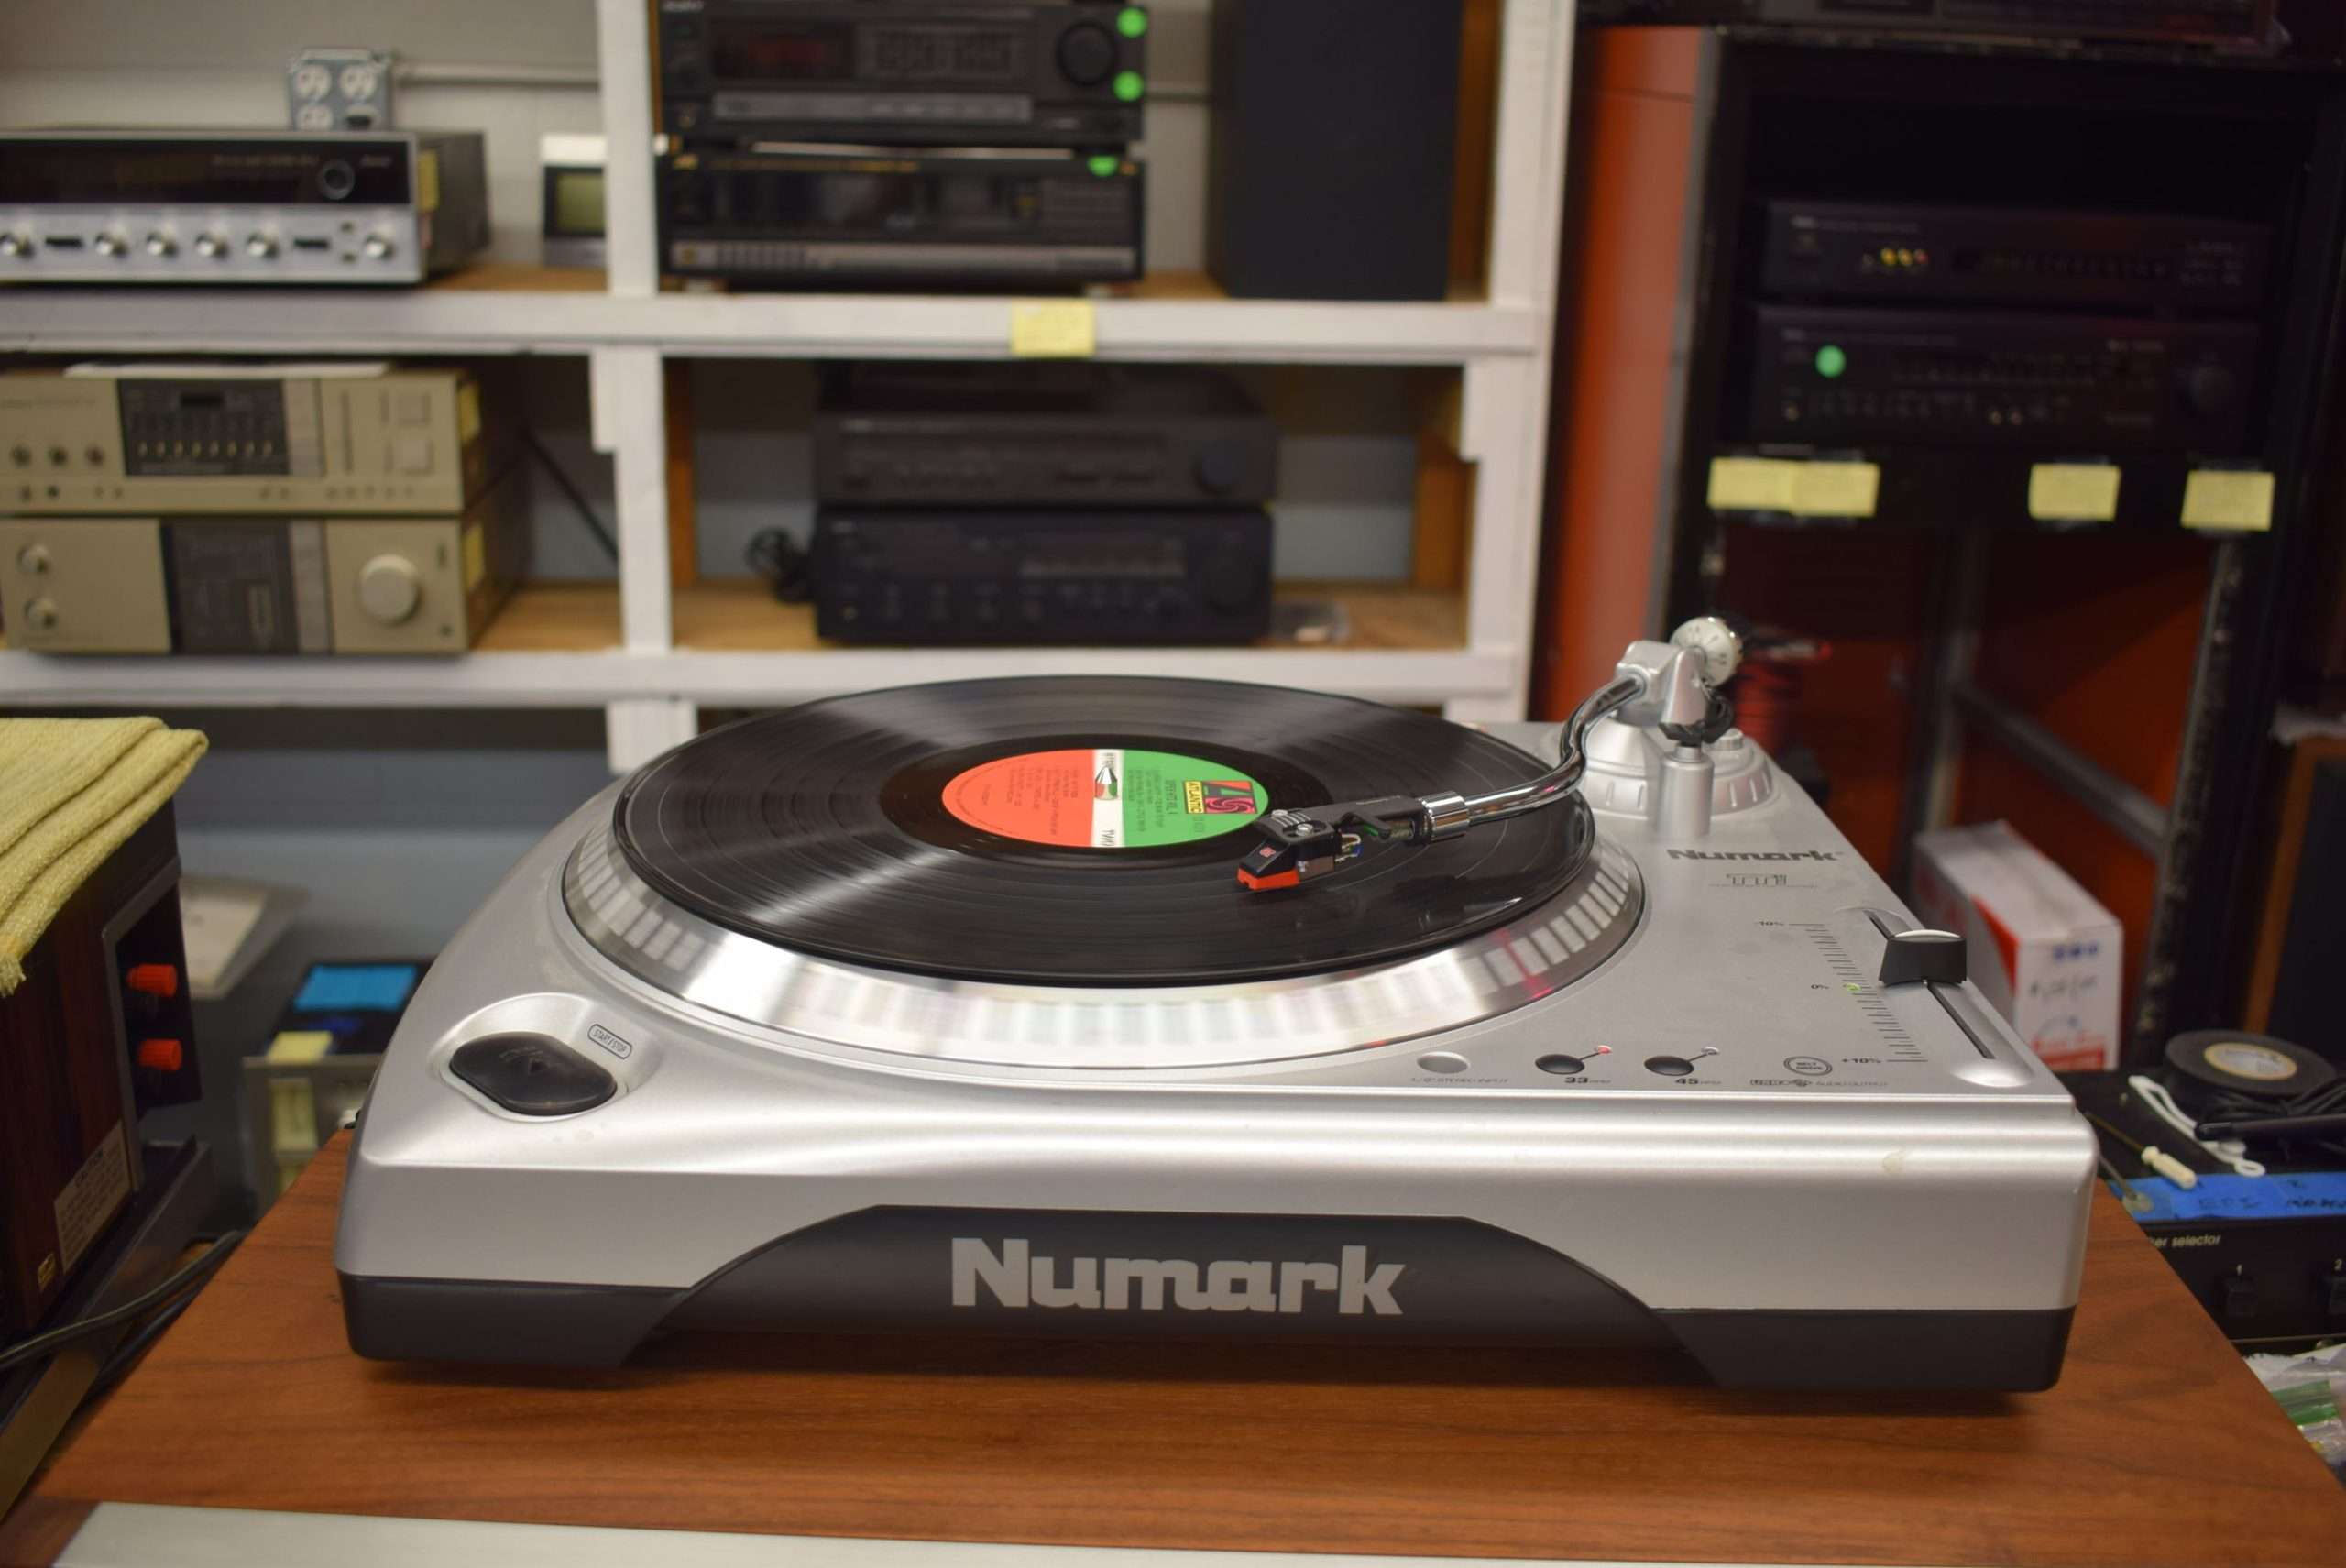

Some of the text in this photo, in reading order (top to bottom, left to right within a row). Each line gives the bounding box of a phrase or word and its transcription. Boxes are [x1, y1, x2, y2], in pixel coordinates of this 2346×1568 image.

[1188, 781, 1202, 813] ATLANTIC
[1667, 850, 1837, 861] Numark
[2171, 1234, 2221, 1247] selector
[2236, 1264, 2243, 1276] 1
[2334, 1258, 2342, 1270] 2
[951, 1237, 1407, 1316] Numark
